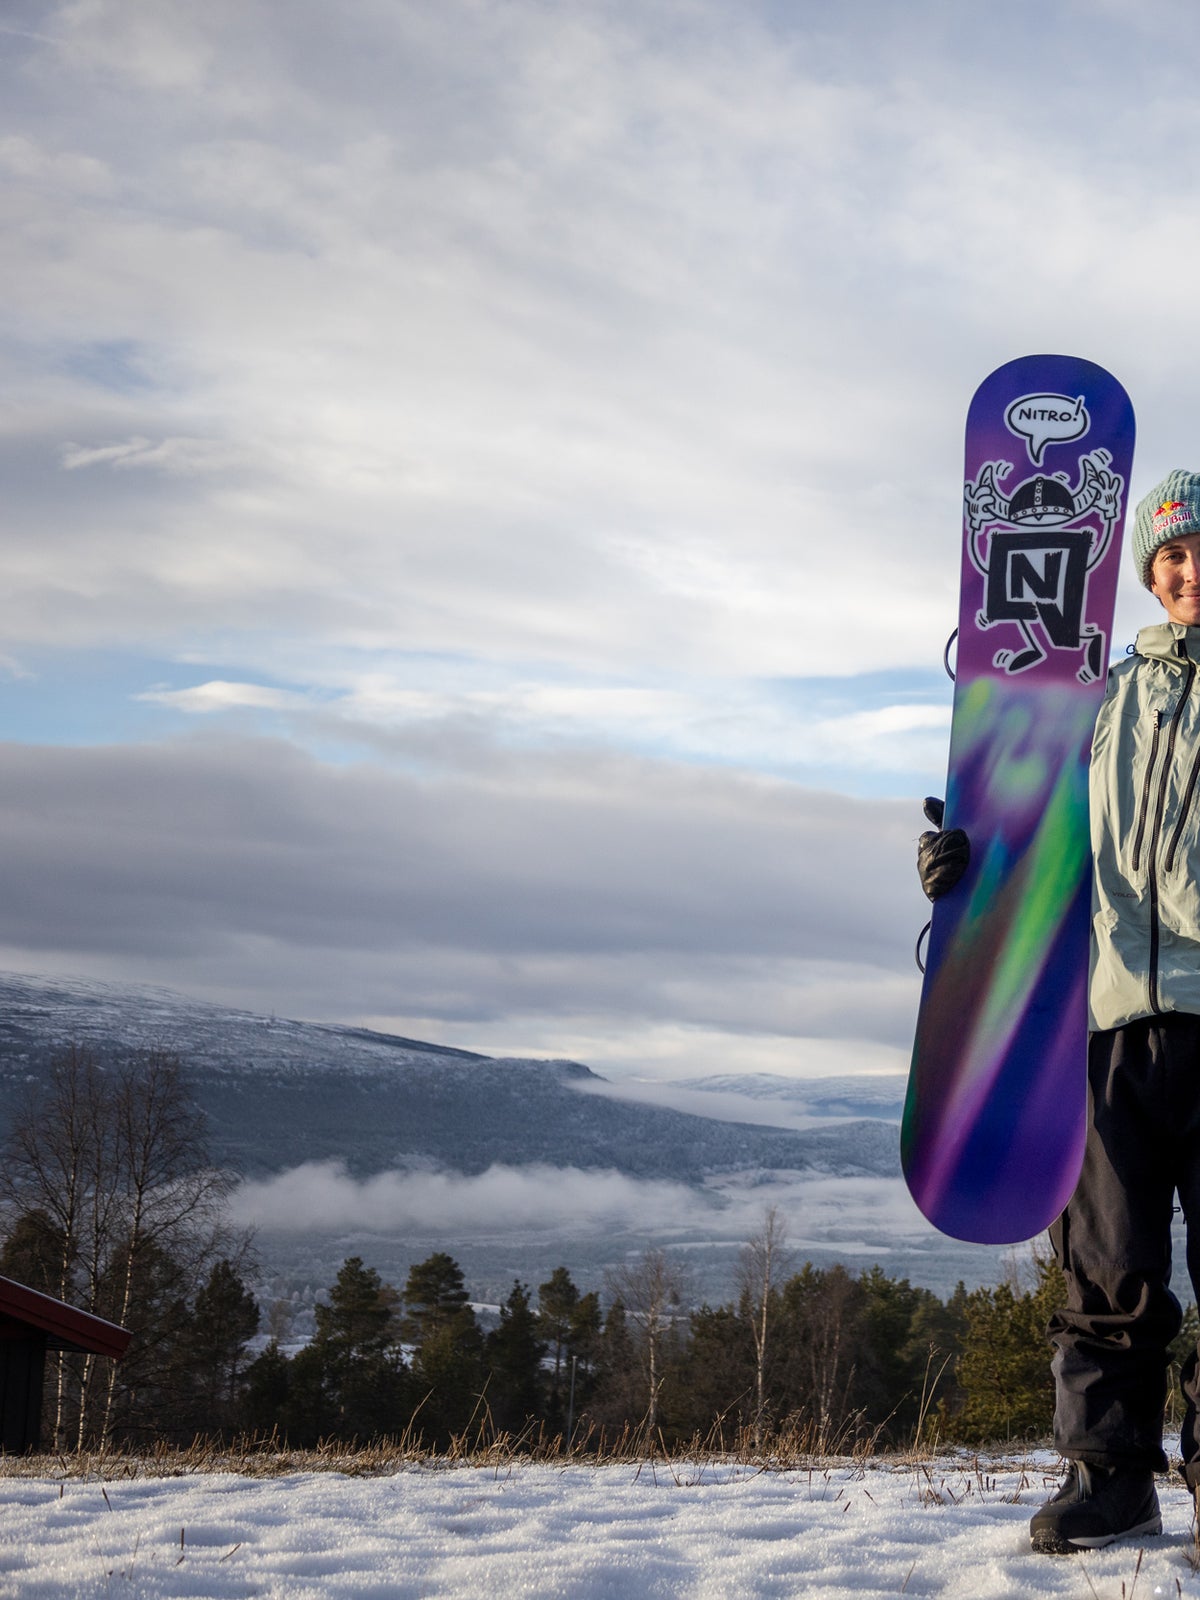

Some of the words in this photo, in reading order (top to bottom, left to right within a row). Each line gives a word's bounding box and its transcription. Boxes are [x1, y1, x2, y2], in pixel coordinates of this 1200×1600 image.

[1018, 399, 1082, 422] NITRO!
[1153, 517, 1169, 534] Red
[1171, 511, 1191, 524] Bull
